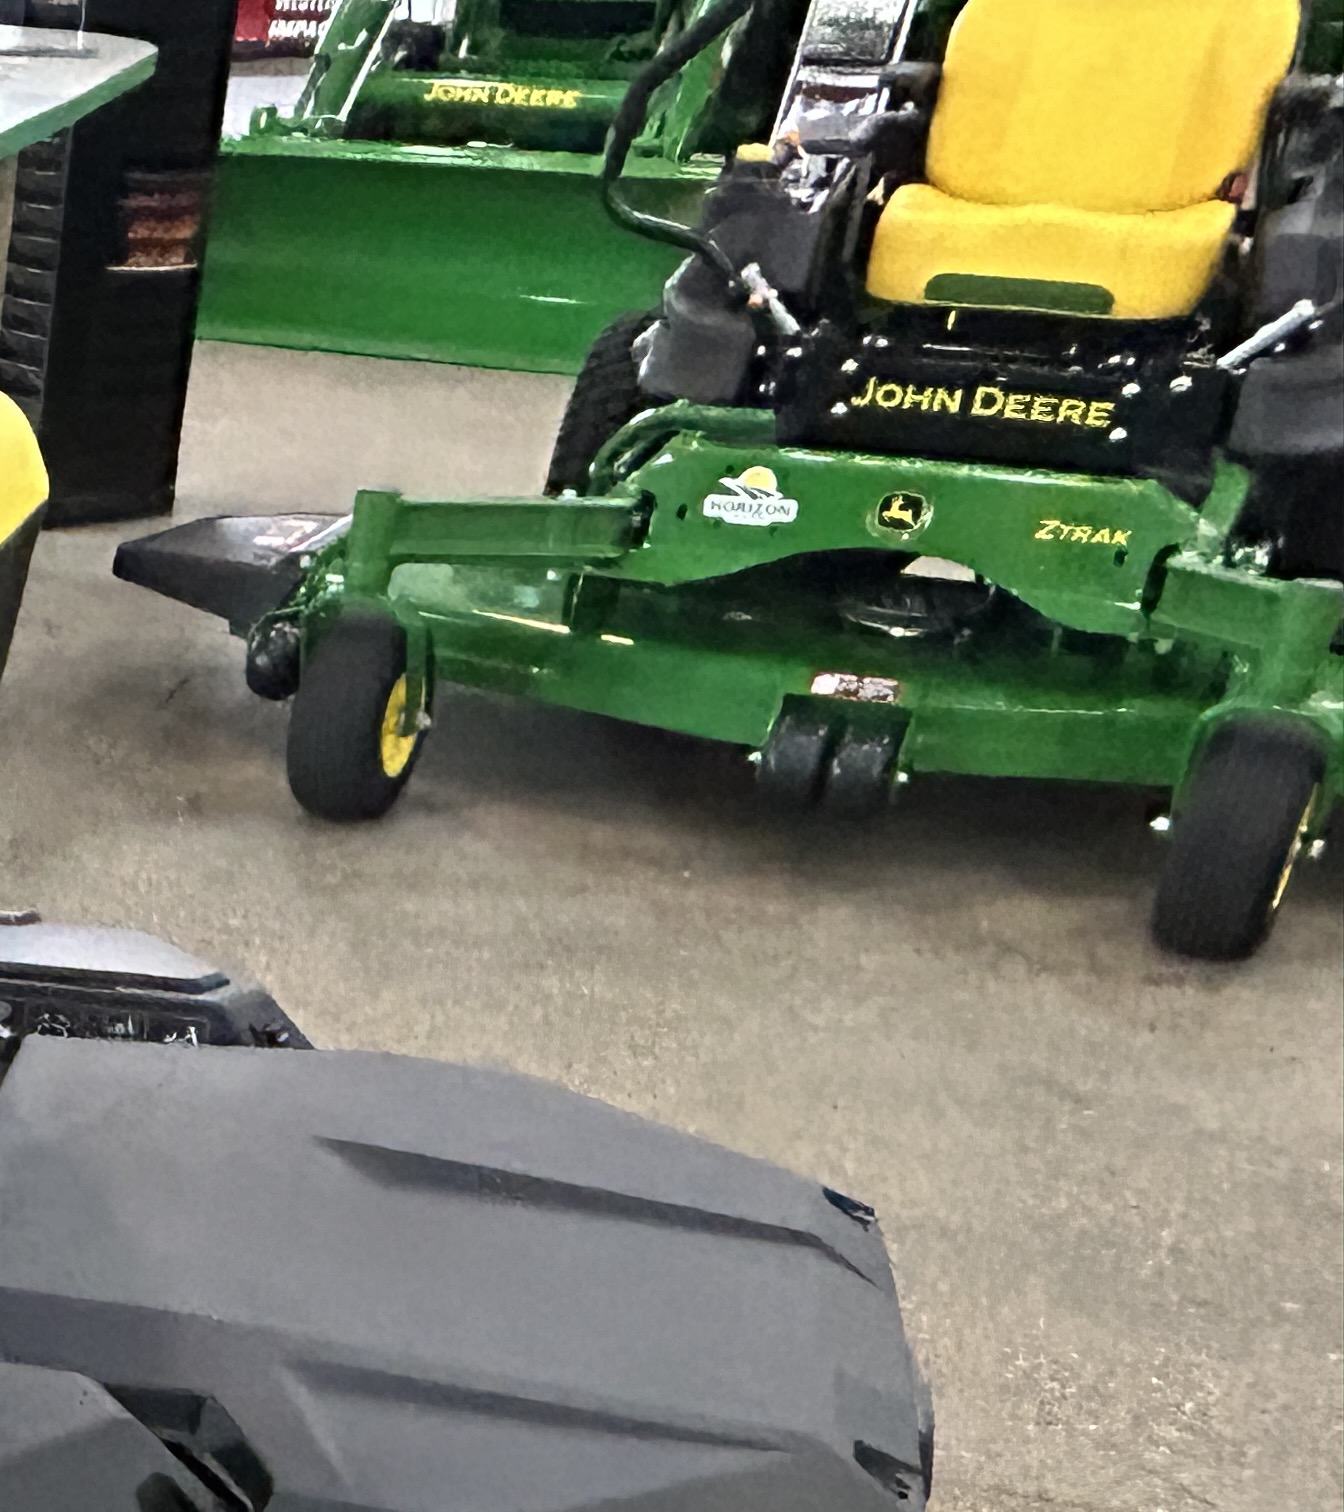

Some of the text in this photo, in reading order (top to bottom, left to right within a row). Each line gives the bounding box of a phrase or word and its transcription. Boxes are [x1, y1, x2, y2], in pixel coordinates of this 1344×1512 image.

[424, 82, 581, 109] JOHN DEERE
[850, 376, 1116, 428] JOHN DEERE
